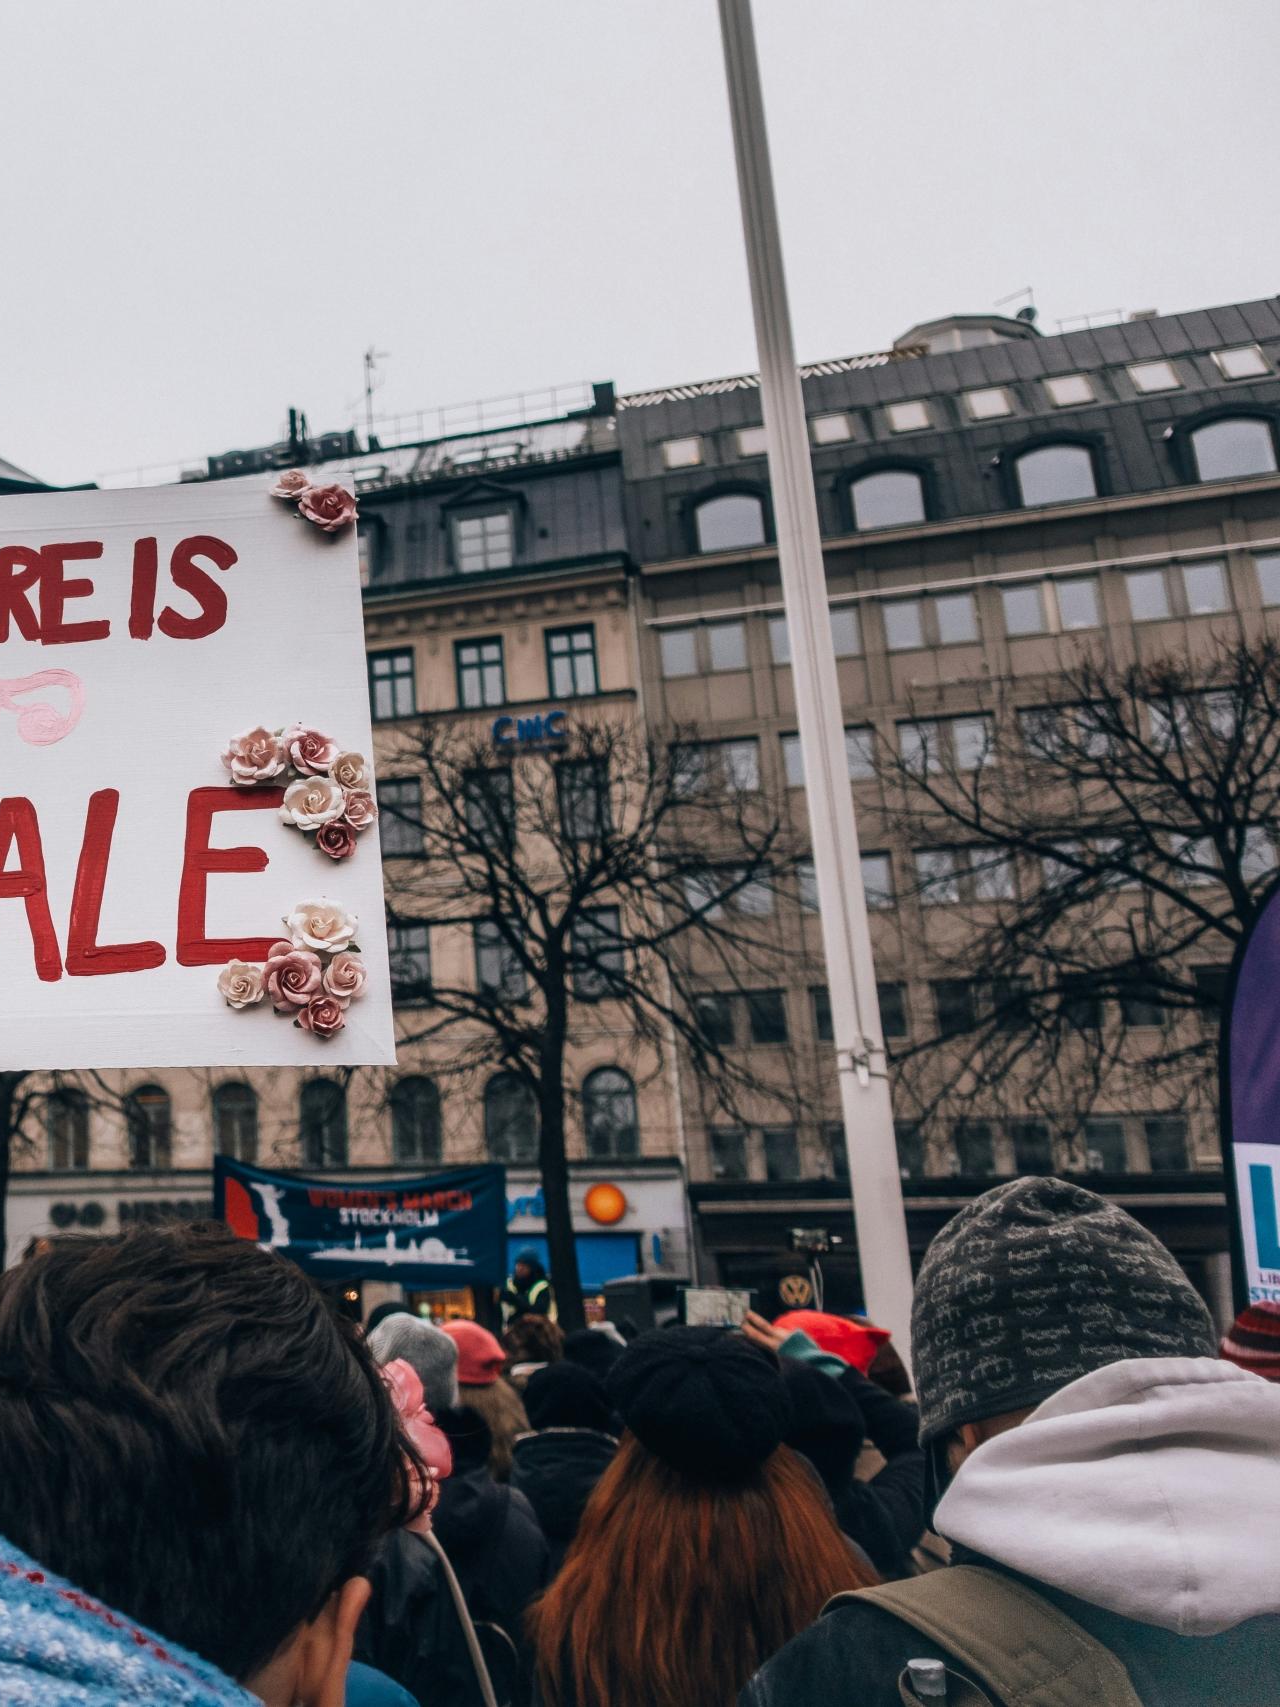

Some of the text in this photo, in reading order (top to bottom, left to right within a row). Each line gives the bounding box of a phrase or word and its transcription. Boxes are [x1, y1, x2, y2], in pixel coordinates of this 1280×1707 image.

[128, 535, 238, 640] IS
[402, 1189, 473, 1211] MARCH
[339, 1207, 440, 1227] STOCKHOLM
